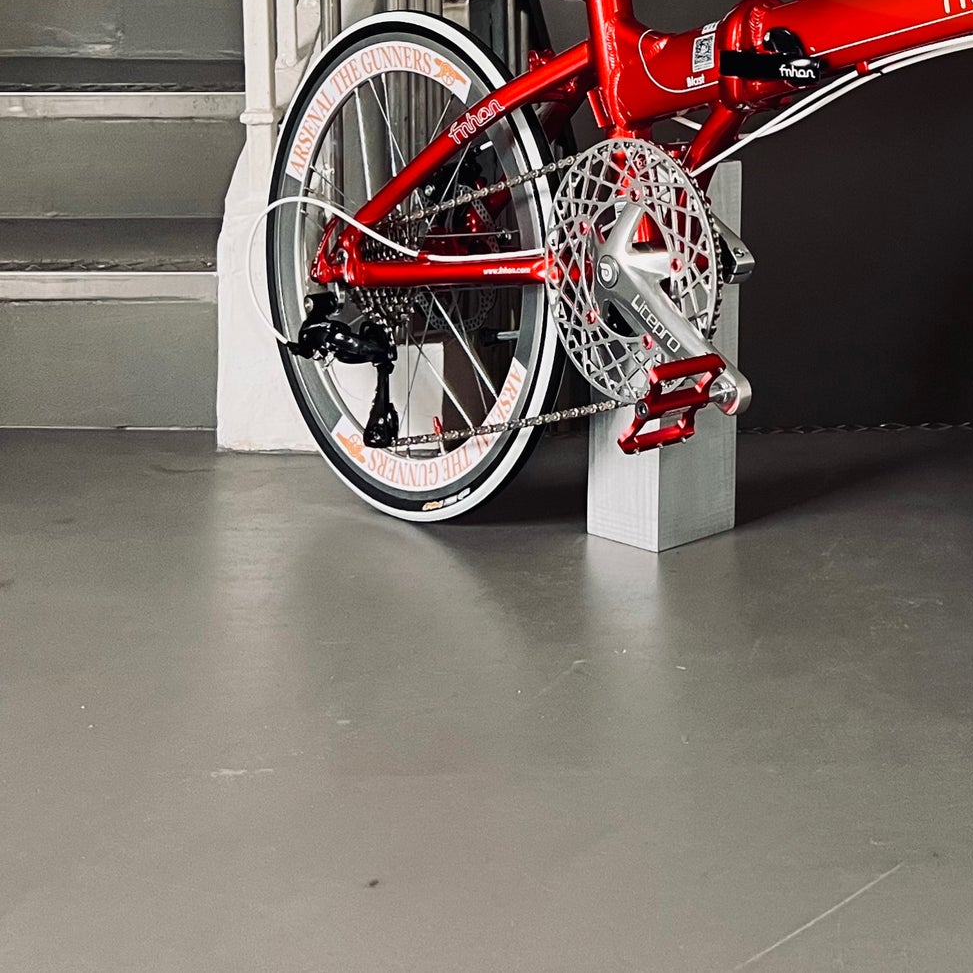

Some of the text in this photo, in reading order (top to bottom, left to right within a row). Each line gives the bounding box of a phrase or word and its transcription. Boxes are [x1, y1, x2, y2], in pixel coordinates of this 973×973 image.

[289, 45, 432, 178] ARSENAL THE GUNNERS
[779, 64, 816, 79] fnhon
[448, 98, 506, 145] fnhon
[367, 362, 522, 487] ARSEAL THE GUNNERS
